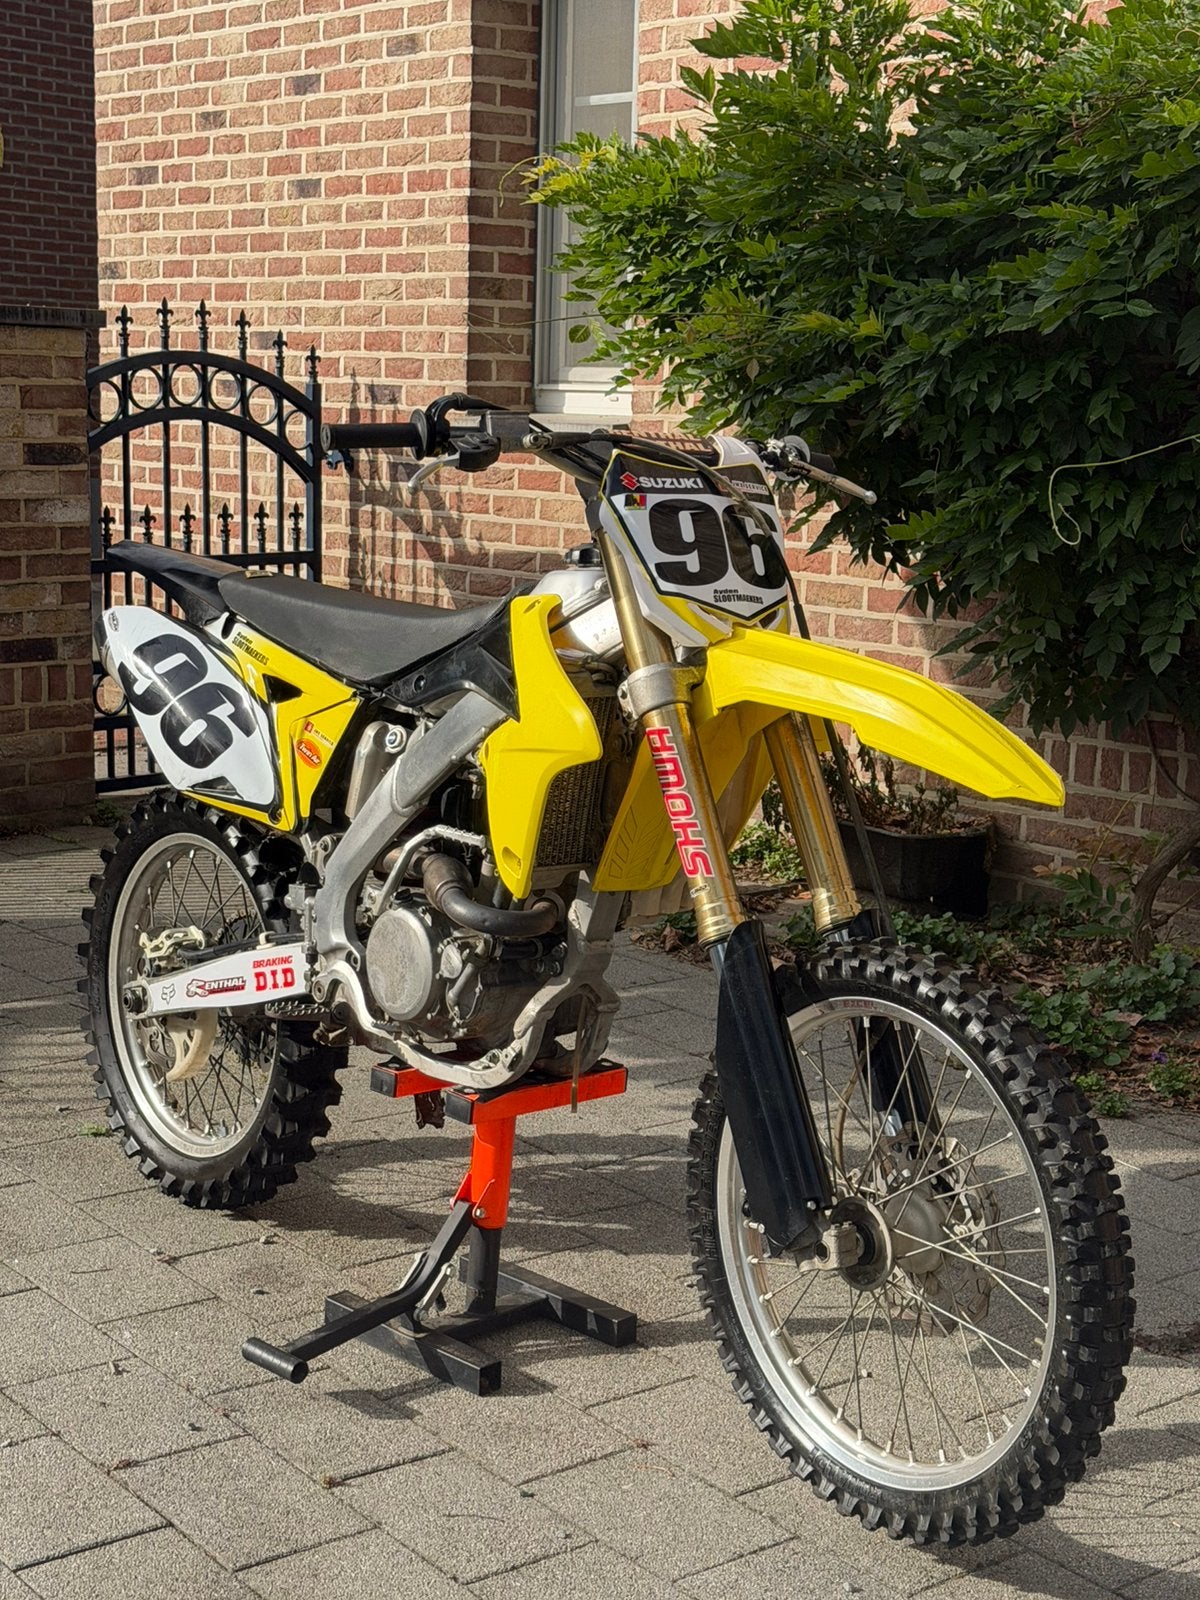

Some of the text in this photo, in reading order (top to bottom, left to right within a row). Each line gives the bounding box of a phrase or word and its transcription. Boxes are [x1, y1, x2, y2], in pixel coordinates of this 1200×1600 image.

[639, 476, 703, 488] SUZUKI
[648, 498, 787, 590] 96
[117, 633, 257, 769] 96
[645, 726, 715, 878] SHOWA
[252, 955, 293, 969] BRAKING
[254, 967, 296, 992] D.I.D
[700, 1208, 718, 1260] HIGH
